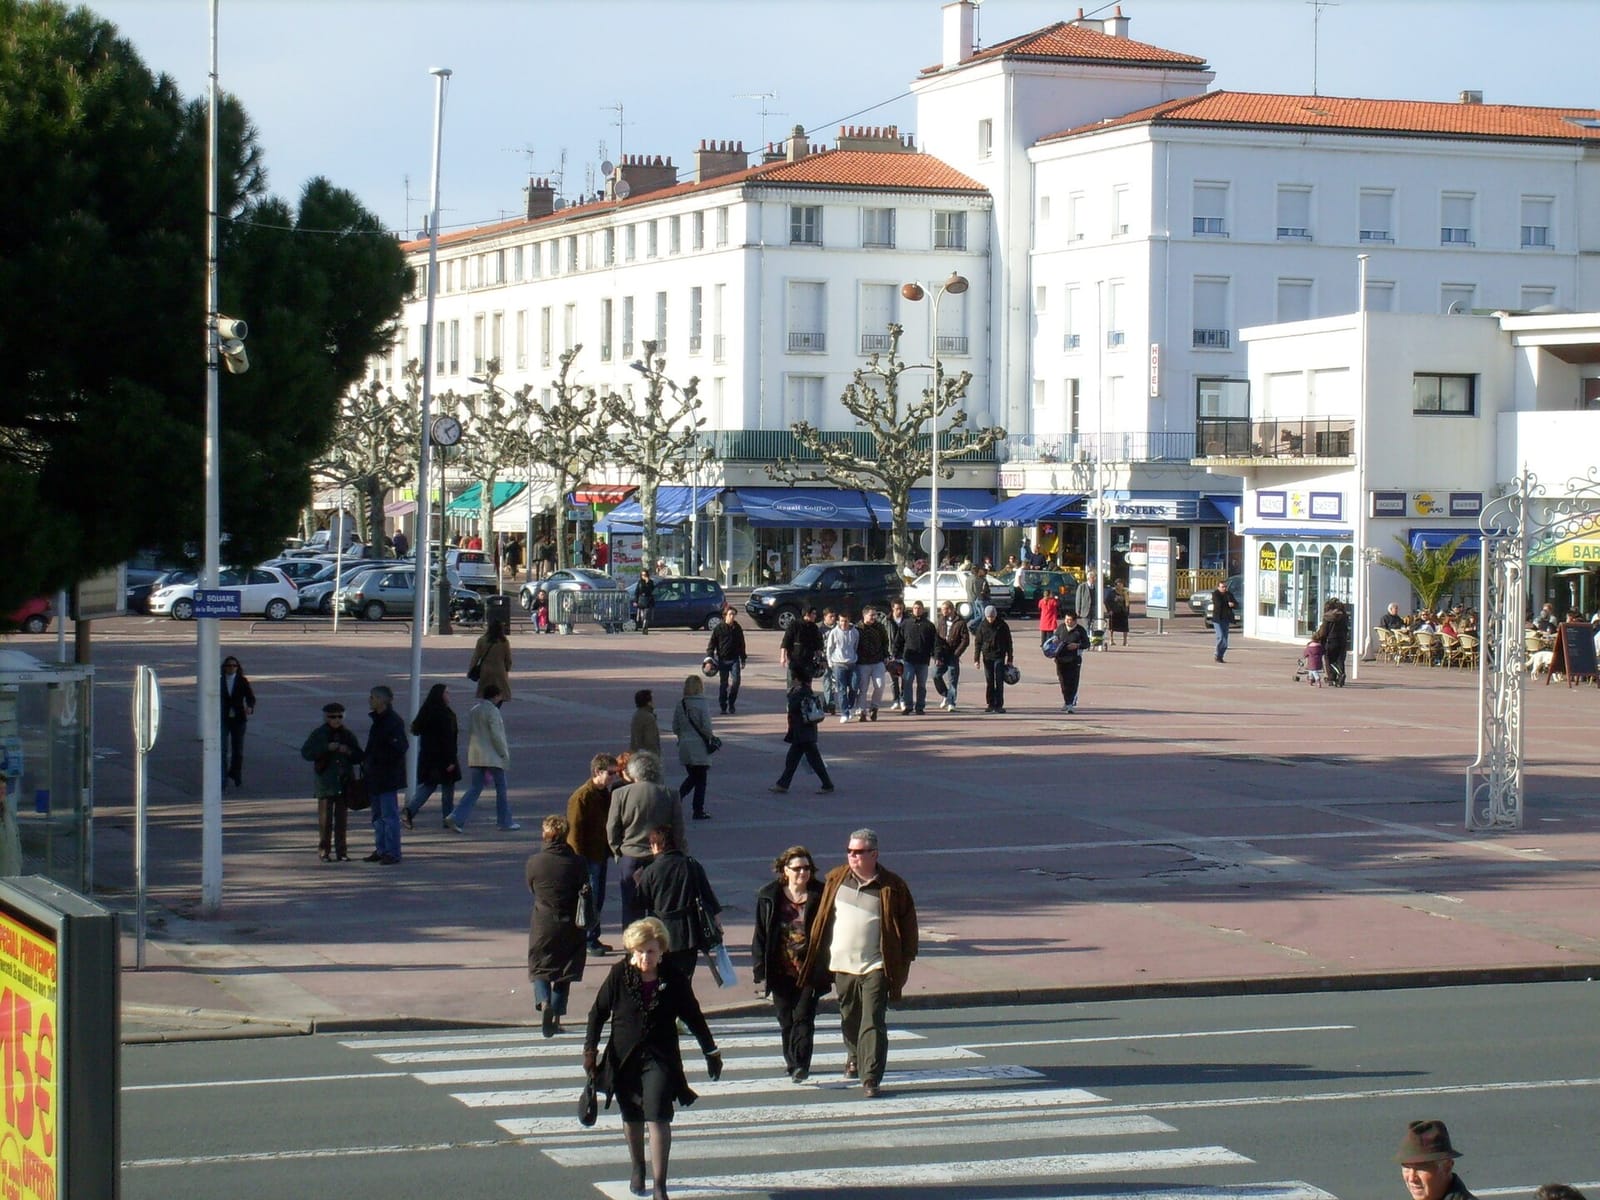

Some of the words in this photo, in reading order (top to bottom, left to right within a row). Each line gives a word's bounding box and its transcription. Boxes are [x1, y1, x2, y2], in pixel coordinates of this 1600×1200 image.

[1151, 346, 1159, 395] HOTEL
[998, 473, 1023, 487] HOTEL
[206, 594, 235, 602] SQUARE
